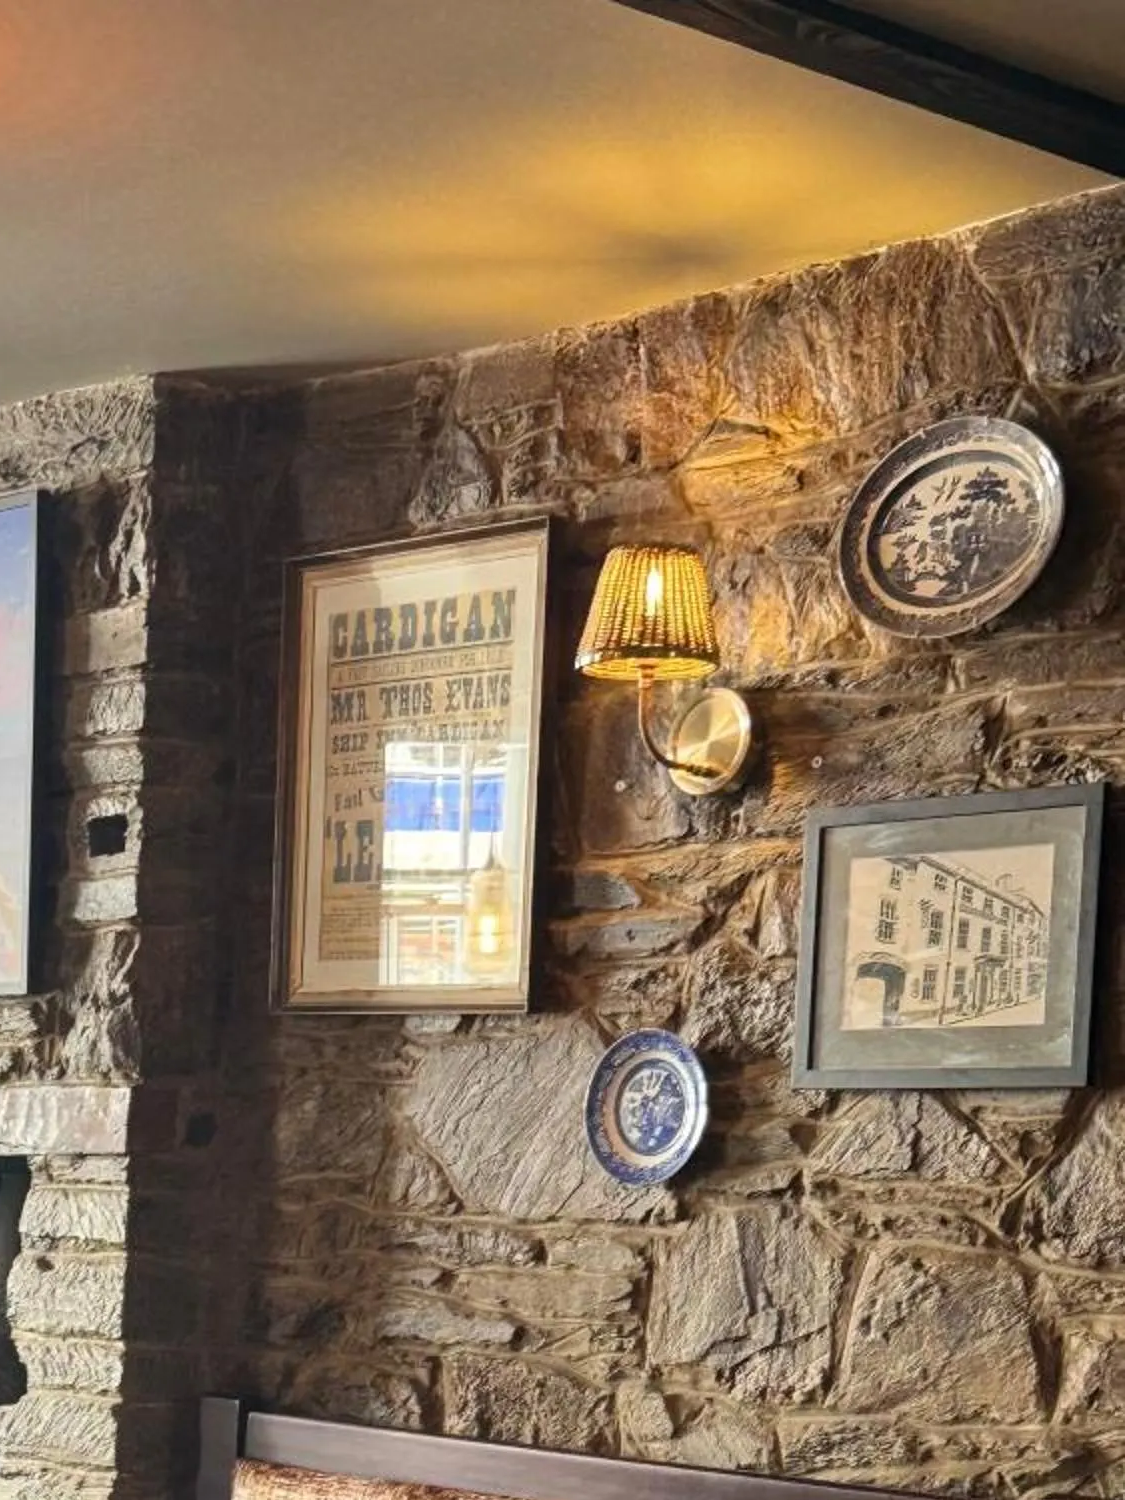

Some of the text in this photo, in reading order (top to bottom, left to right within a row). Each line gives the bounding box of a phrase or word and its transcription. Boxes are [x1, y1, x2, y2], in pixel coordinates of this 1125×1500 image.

[331, 590, 516, 658] CARDIGAN
[445, 673, 512, 714] EVANS
[331, 731, 369, 755] SHIP
